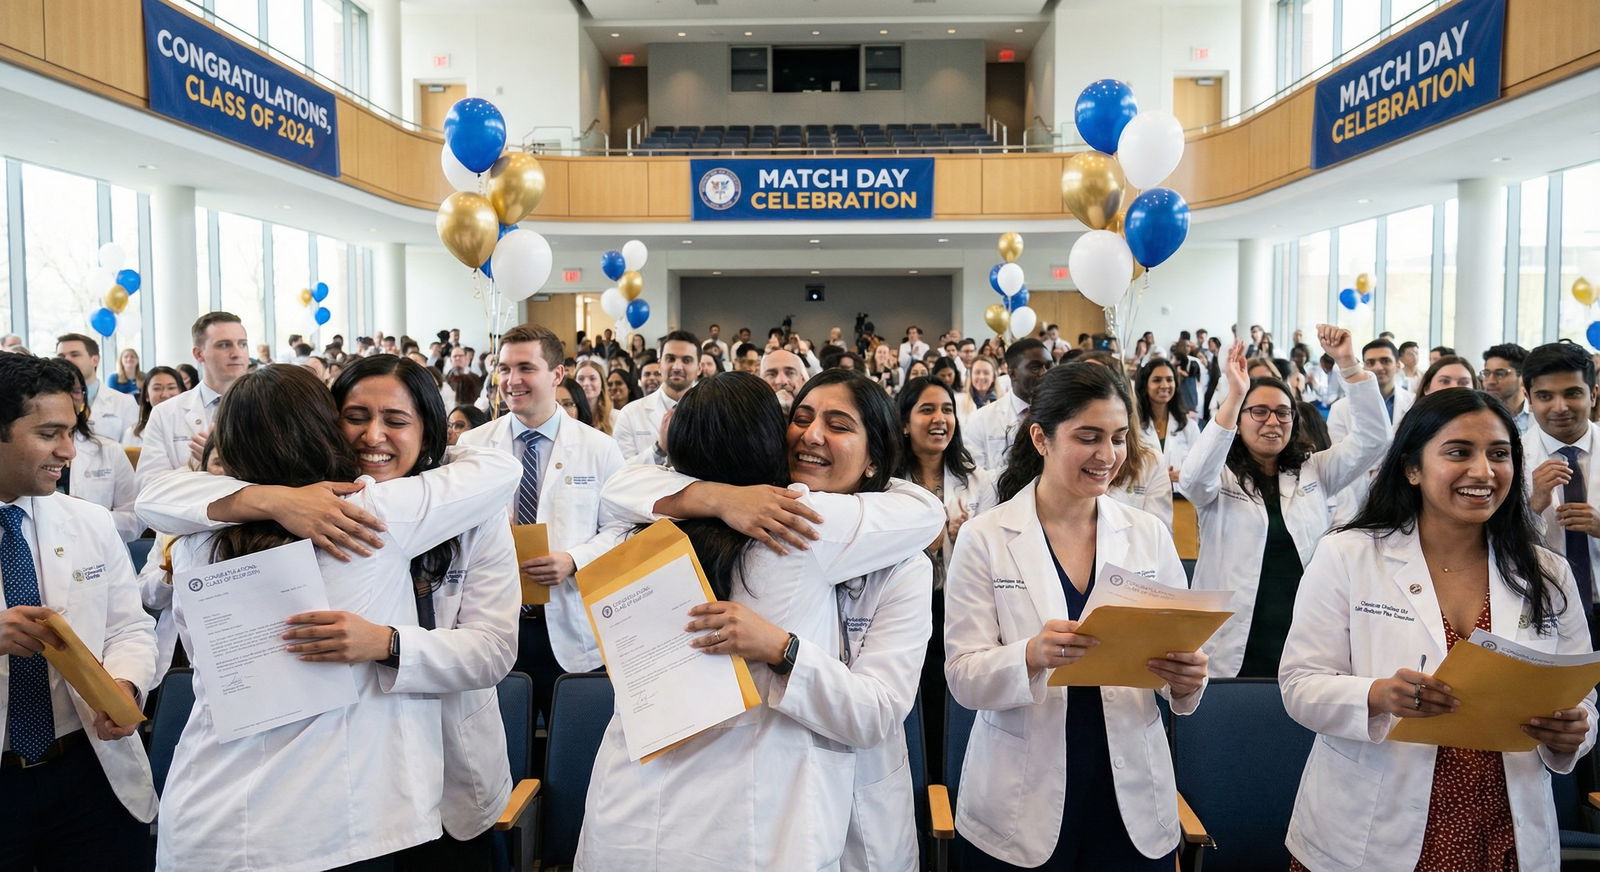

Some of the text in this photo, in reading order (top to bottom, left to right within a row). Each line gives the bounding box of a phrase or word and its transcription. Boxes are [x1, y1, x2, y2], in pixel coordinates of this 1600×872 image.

[157, 29, 332, 135] CONGRATULATIONS,
[1332, 57, 1475, 144] CELEBRATION
[1340, 20, 1469, 112] MATCH DAY
[185, 74, 315, 148] CLASS OF 2024
[750, 191, 917, 210] CELEBRATION
[759, 168, 849, 189] MATCH
[856, 168, 910, 189] DAY
